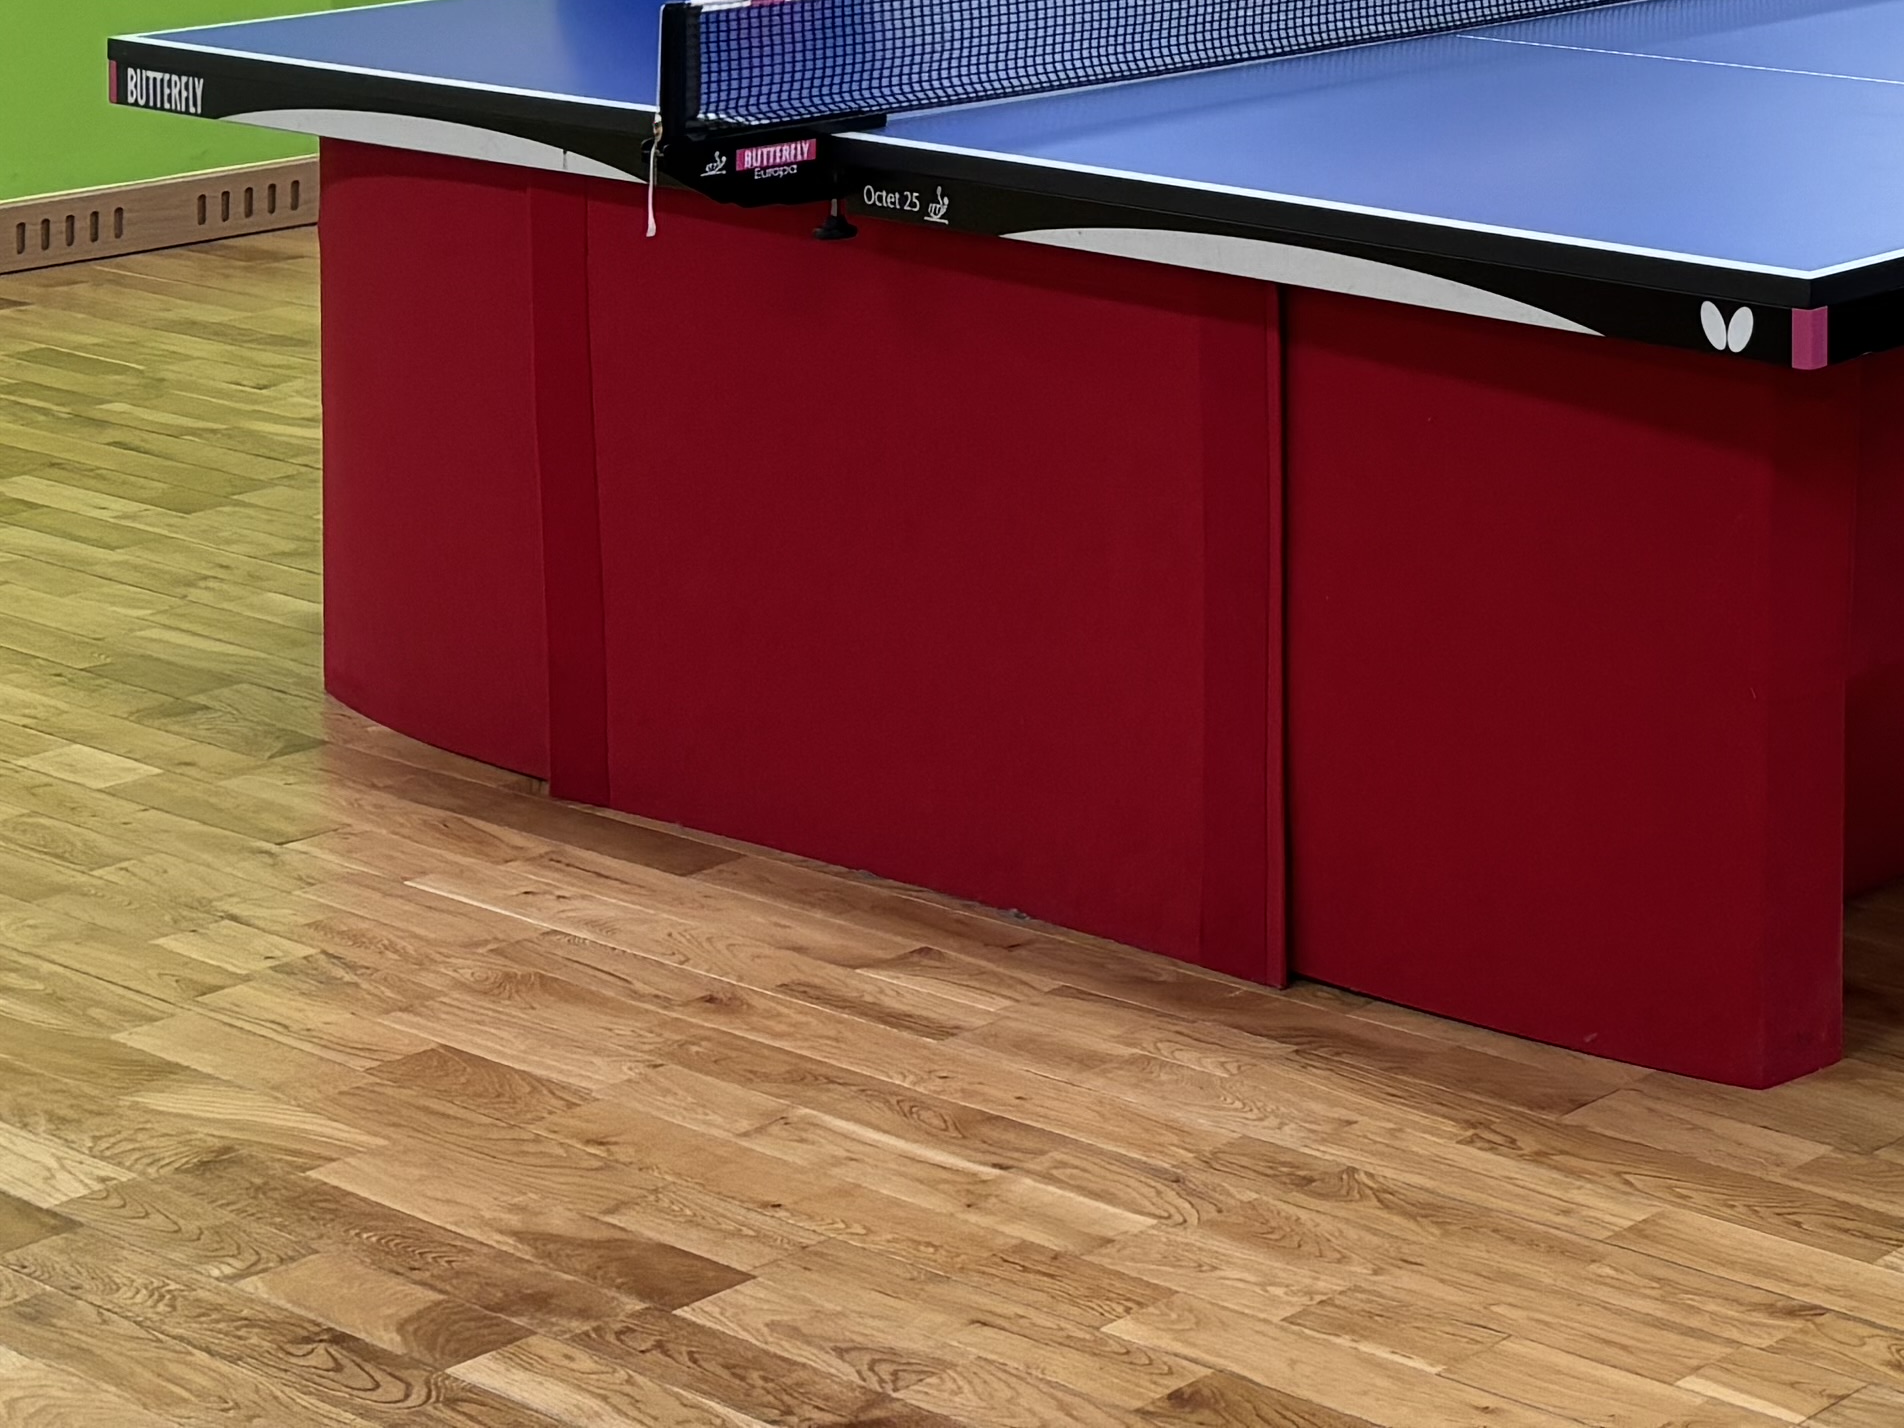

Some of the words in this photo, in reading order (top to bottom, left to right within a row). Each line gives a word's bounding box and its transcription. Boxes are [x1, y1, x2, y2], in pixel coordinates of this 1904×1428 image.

[127, 67, 204, 114] BUTTERFLY
[744, 140, 810, 169] BUTTERFLY
[754, 165, 798, 179] Europa
[863, 185, 900, 209] Octet
[904, 191, 920, 211] 25
